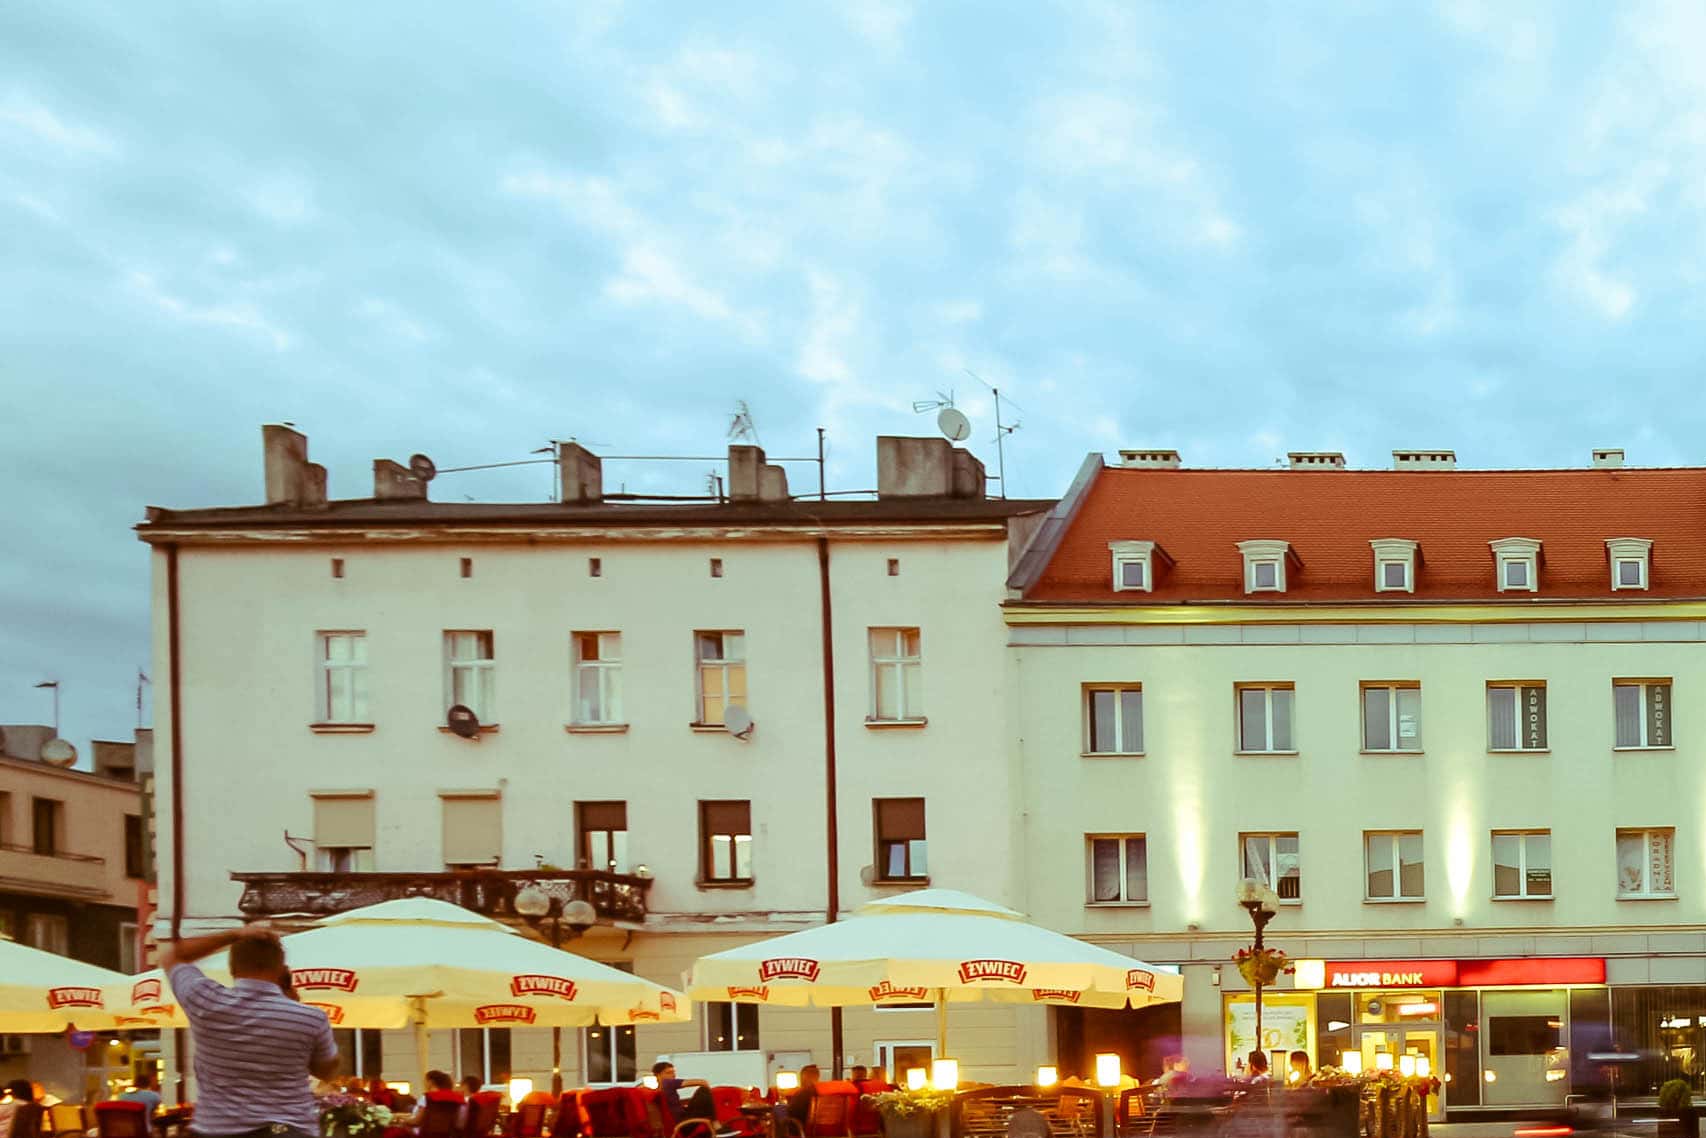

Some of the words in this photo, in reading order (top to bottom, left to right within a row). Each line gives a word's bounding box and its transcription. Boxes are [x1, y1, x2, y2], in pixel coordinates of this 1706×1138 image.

[1528, 688, 1539, 748] ADWOKAT
[967, 961, 1020, 979] ŻYWIEC
[1382, 972, 1424, 985] BANK
